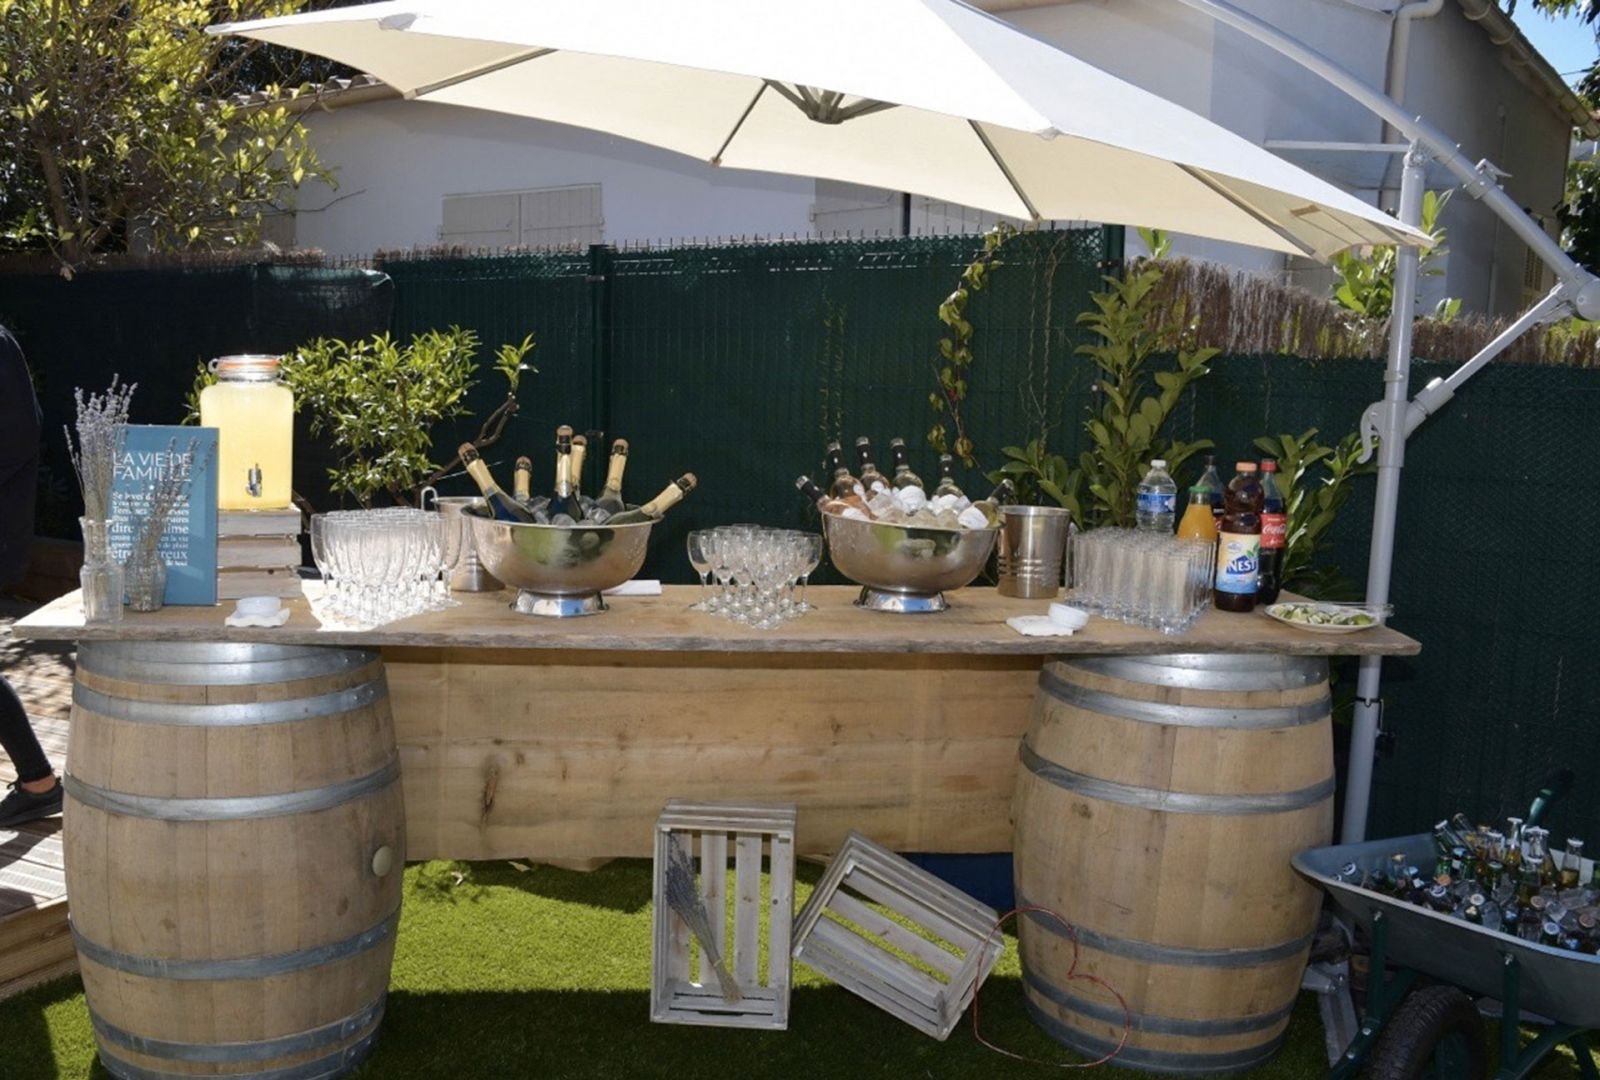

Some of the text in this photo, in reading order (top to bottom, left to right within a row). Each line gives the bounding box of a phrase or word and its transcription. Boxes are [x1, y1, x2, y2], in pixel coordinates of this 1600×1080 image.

[113, 452, 192, 467] LA VIE DE
[111, 522, 135, 534] dire
